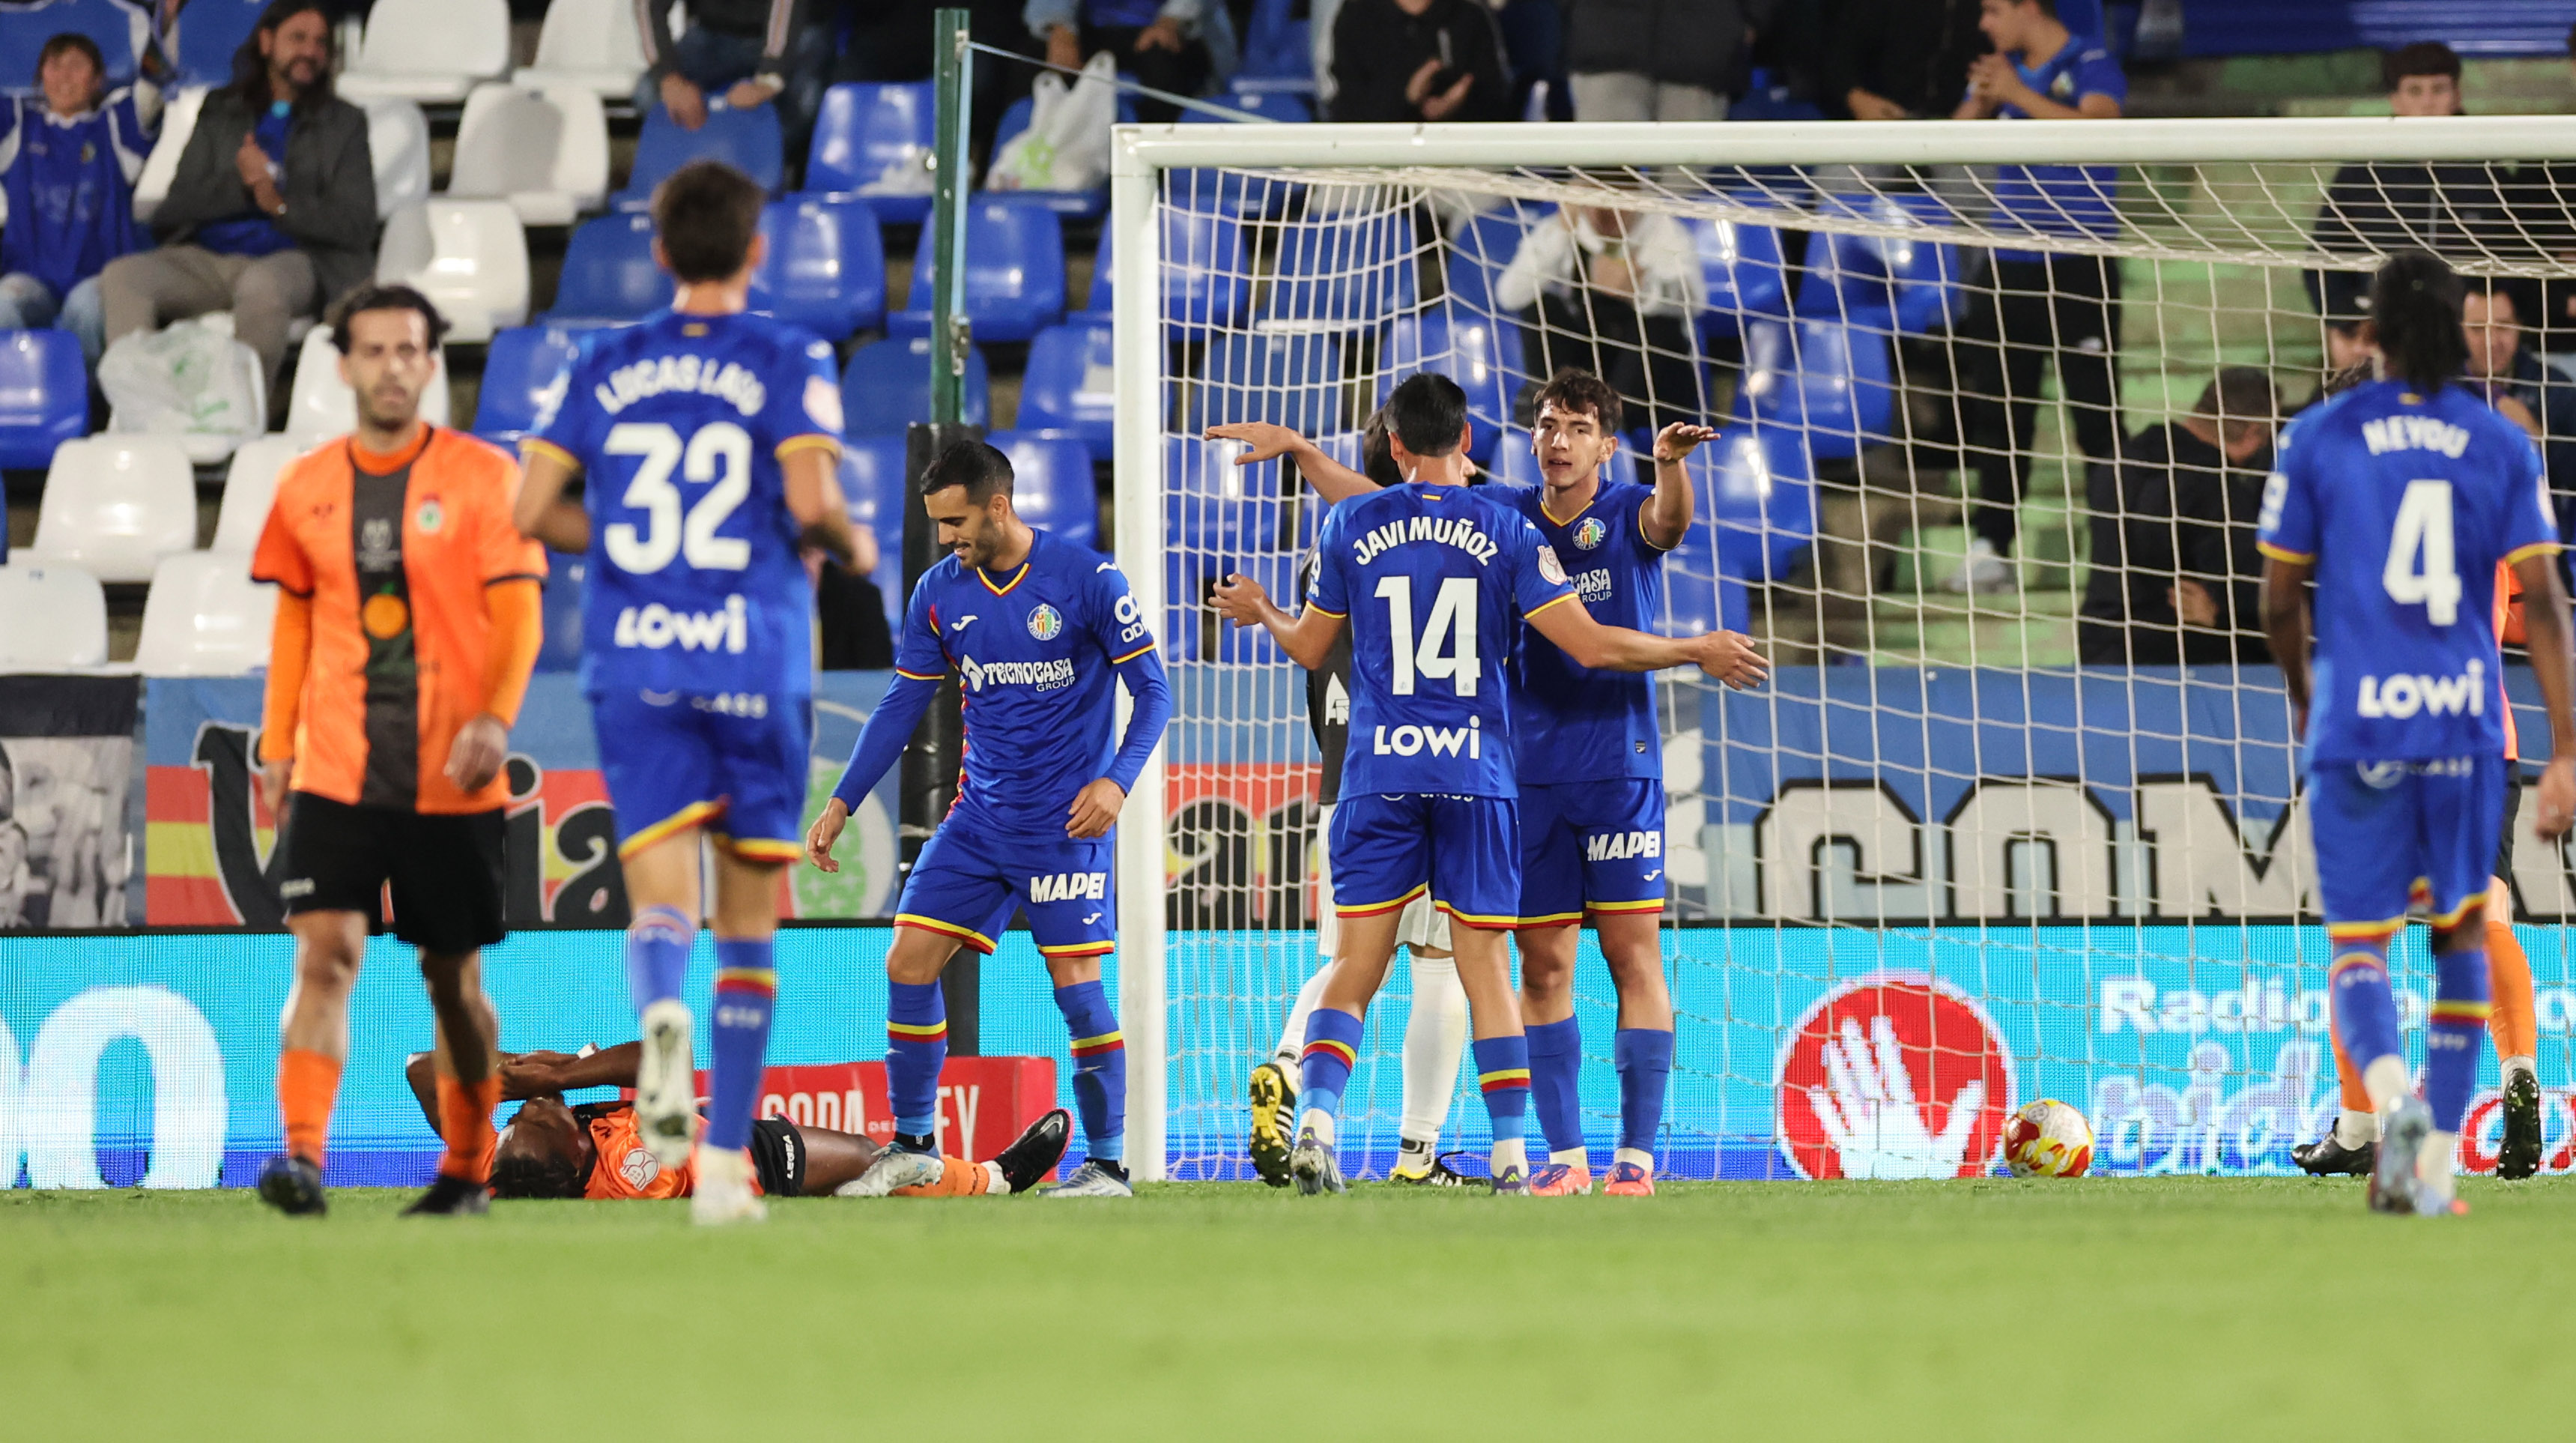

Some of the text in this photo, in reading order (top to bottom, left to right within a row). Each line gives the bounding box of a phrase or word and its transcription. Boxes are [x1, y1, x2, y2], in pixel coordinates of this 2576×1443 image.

[595, 354, 702, 415] LUCAS
[603, 422, 751, 575] 32
[1354, 516, 1498, 566] JAVI MUÑOZ
[2382, 480, 2462, 626] 4
[1582, 590, 1613, 603] ROUP
[1121, 620, 1150, 643] OD
[1374, 575, 1481, 697] 14
[983, 657, 1074, 686] TECNOCASA
[1036, 676, 1076, 692] GROUP
[1587, 830, 1661, 862] MAPEI
[1031, 872, 1106, 904] MAPEI
[2099, 975, 2336, 1033] Radio
[934, 1084, 980, 1161] EY
[782, 1134, 795, 1180] LEGEA
